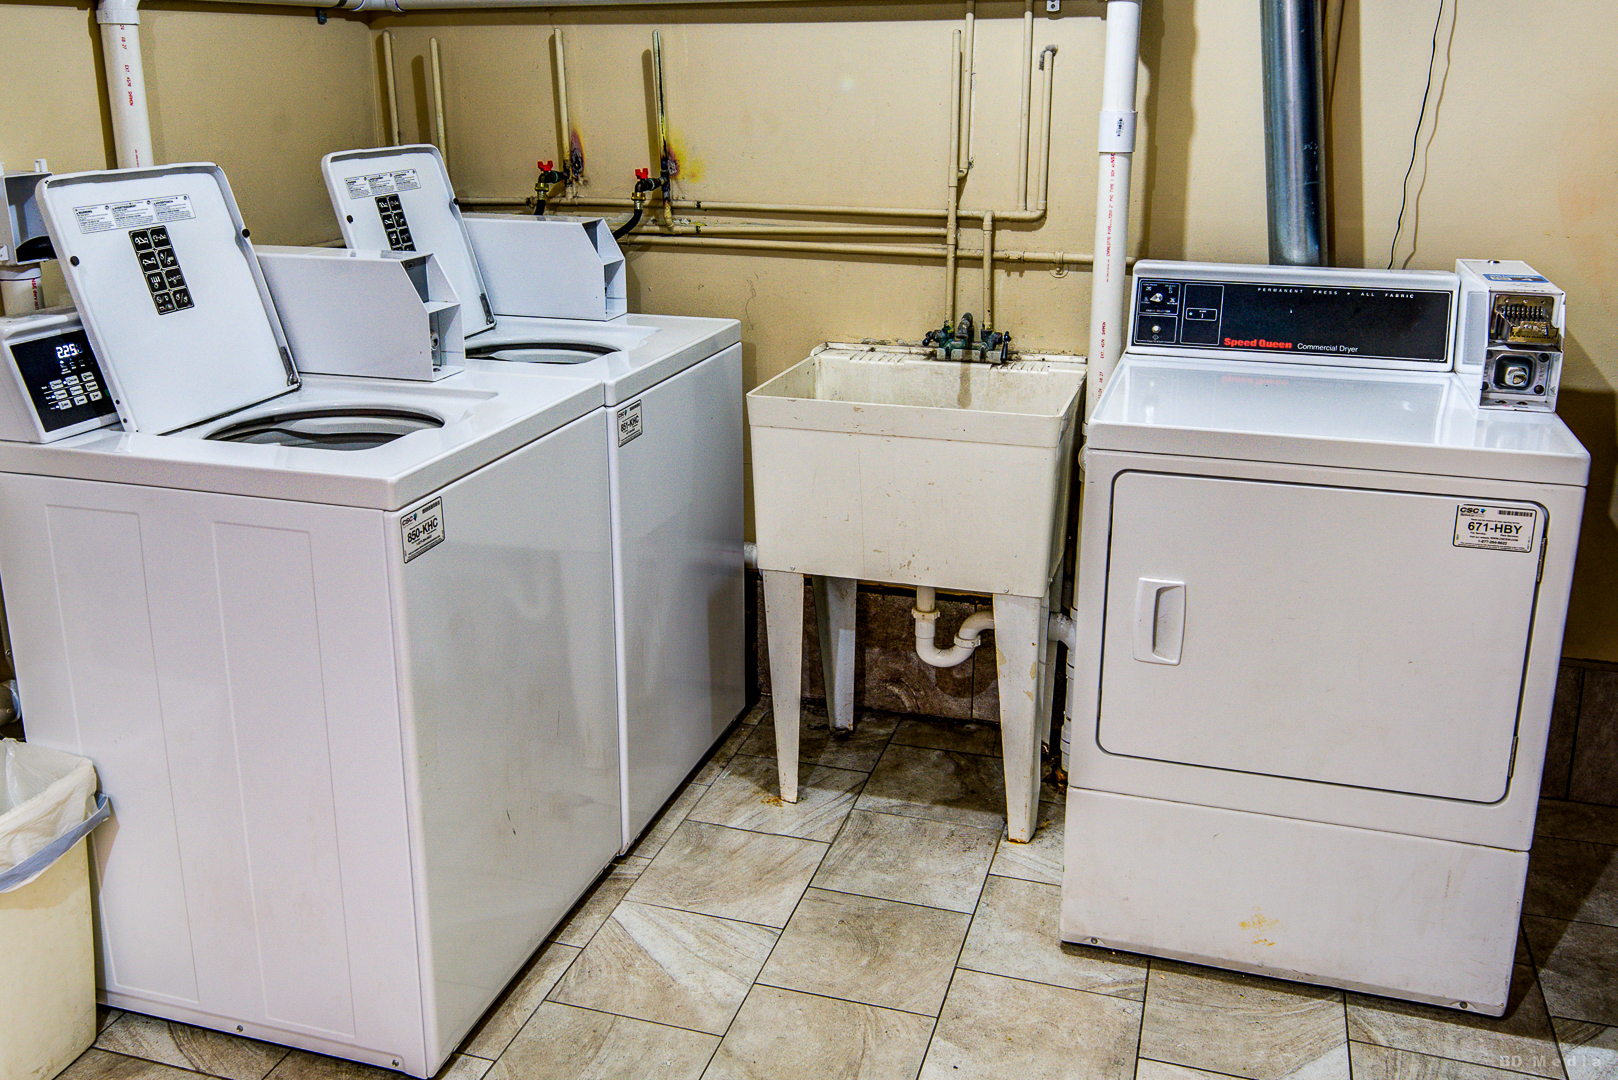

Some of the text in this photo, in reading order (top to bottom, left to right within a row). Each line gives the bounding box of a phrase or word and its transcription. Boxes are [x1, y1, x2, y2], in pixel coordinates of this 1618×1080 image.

[1224, 337, 1359, 353] Speed Queen Commercial Dryer
[407, 517, 438, 543] 850-KHC
[1467, 521, 1523, 535] 671-HBY
